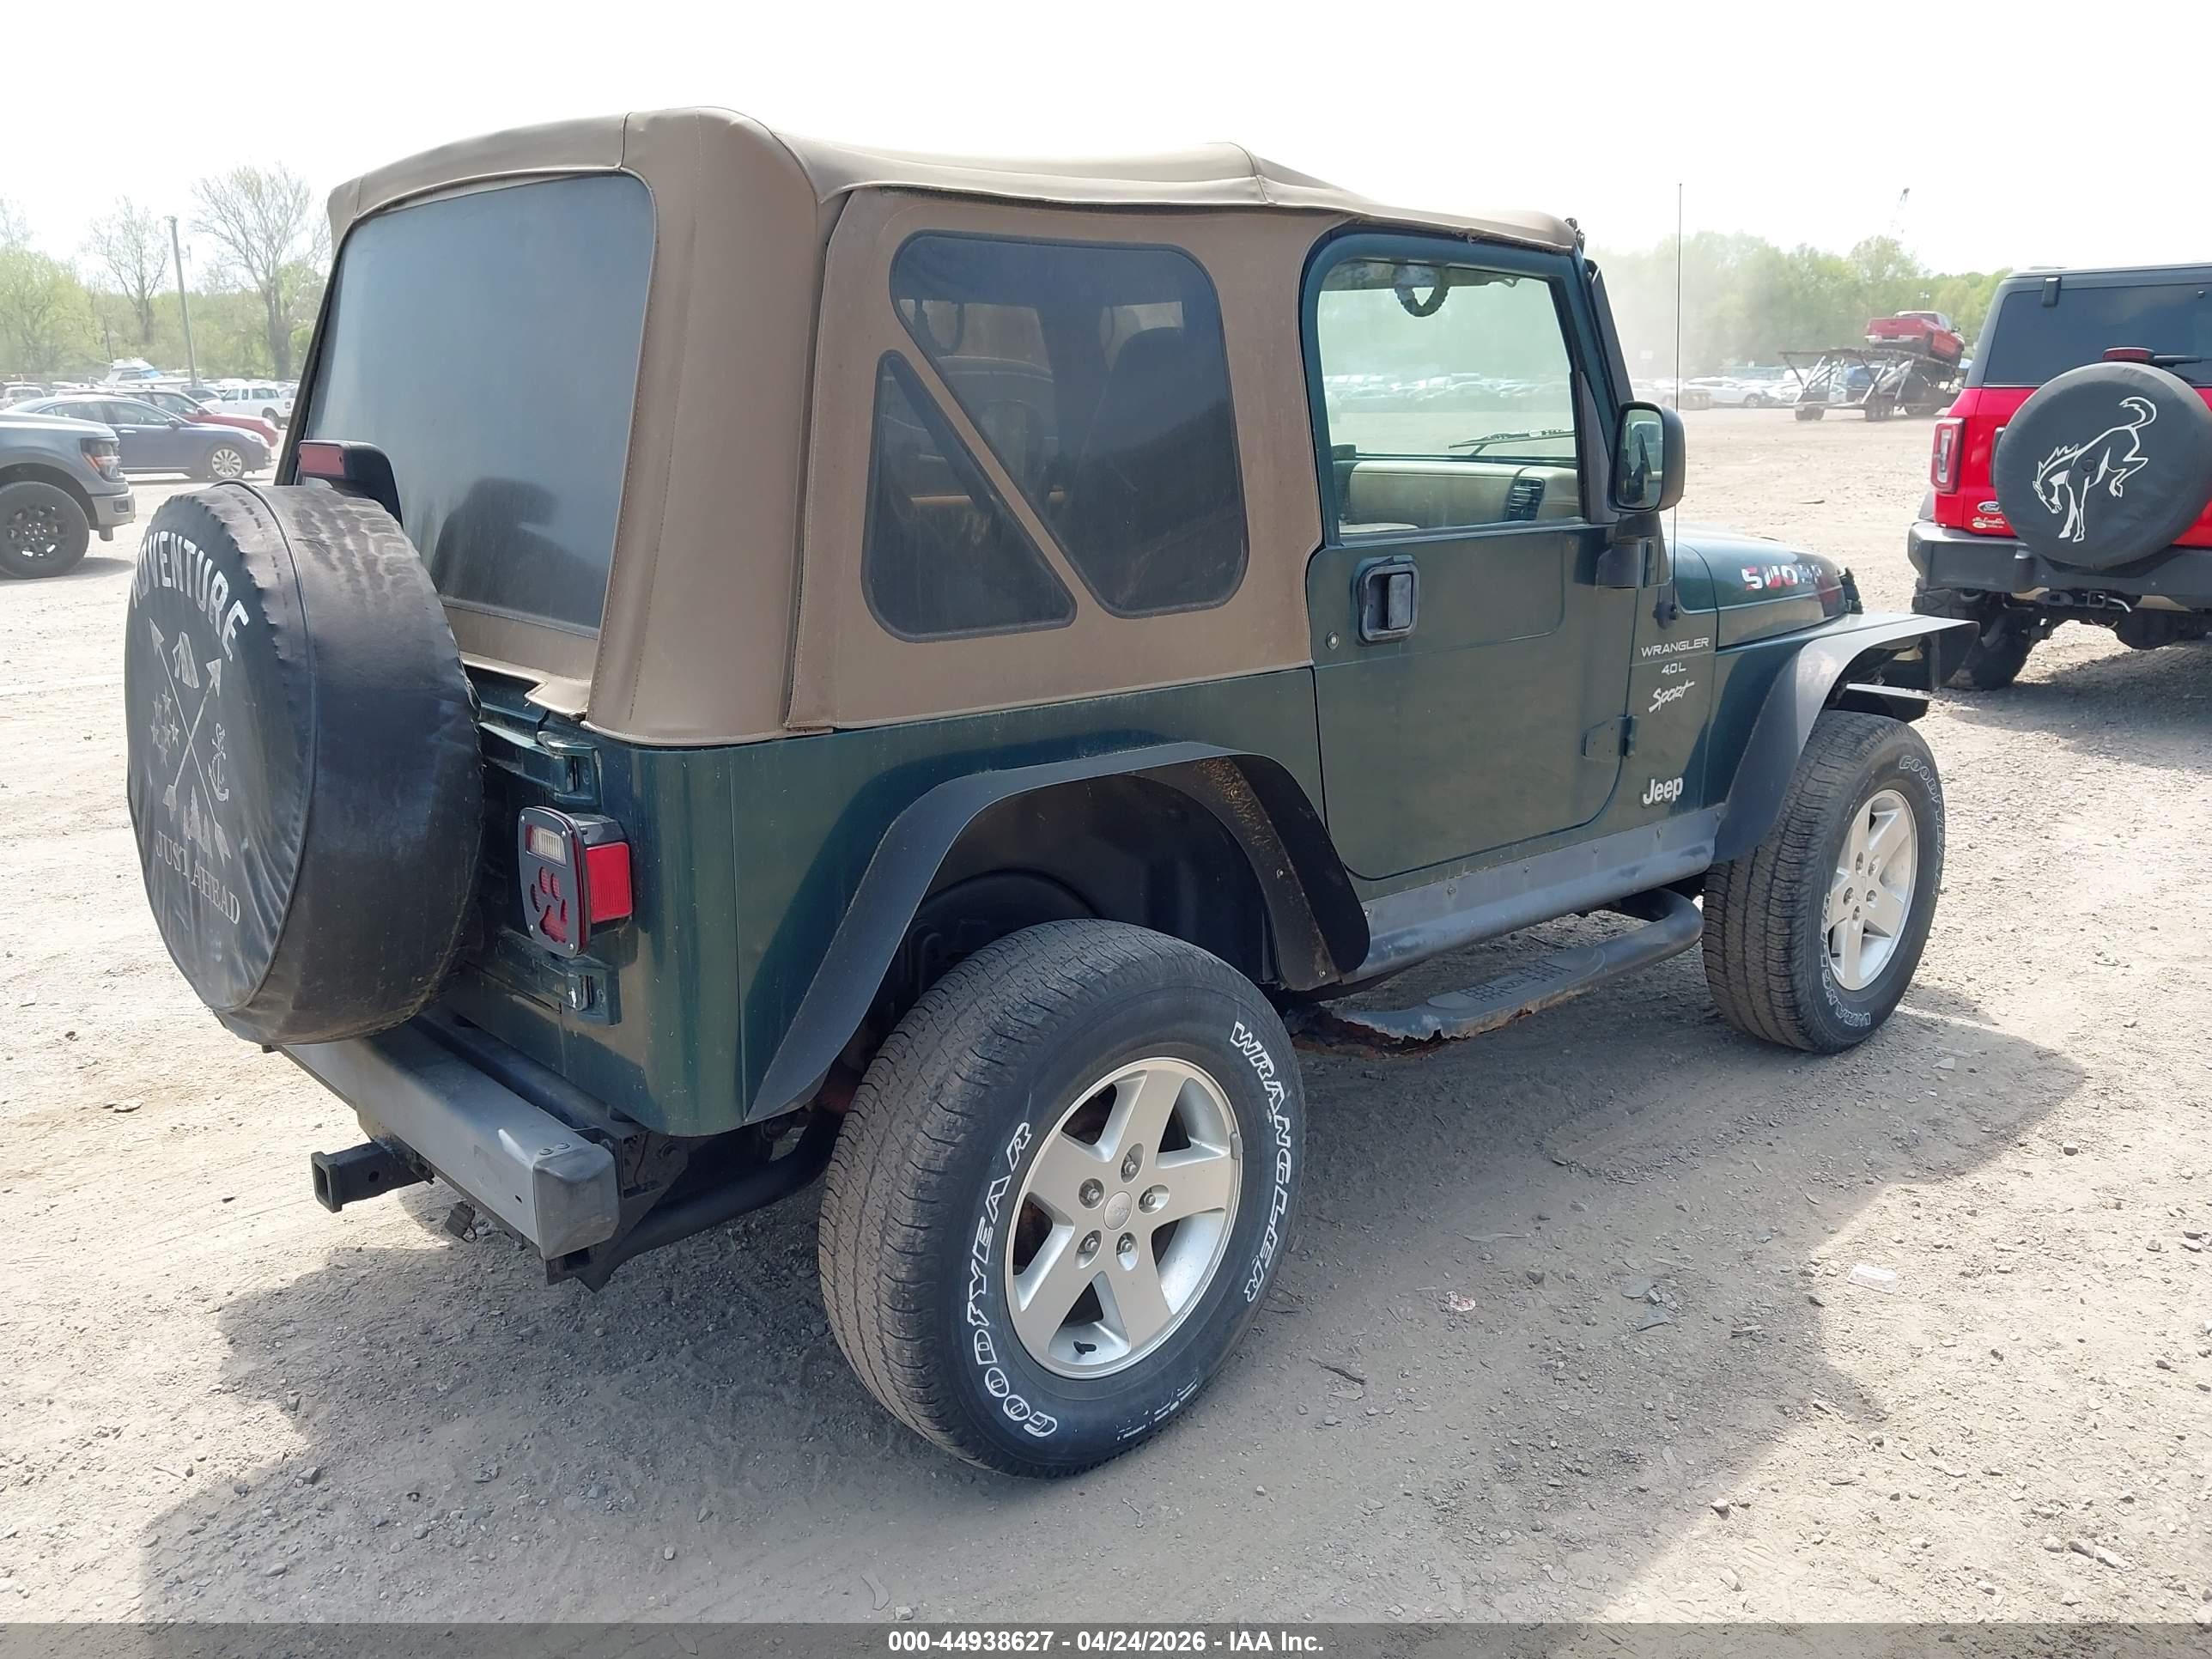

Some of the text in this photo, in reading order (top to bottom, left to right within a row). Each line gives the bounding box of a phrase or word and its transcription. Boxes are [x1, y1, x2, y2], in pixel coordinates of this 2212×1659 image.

[132, 531, 250, 662] ADVENTURE
[1640, 637, 1710, 658] WRANGLER
[1642, 776, 1684, 805] Jeep
[1898, 755, 1945, 898] GOODYEAR
[155, 830, 240, 925] JUST AHEAD
[1230, 1021, 1292, 1304] WRANGLER
[967, 1121, 1059, 1438] GOODYEAR
